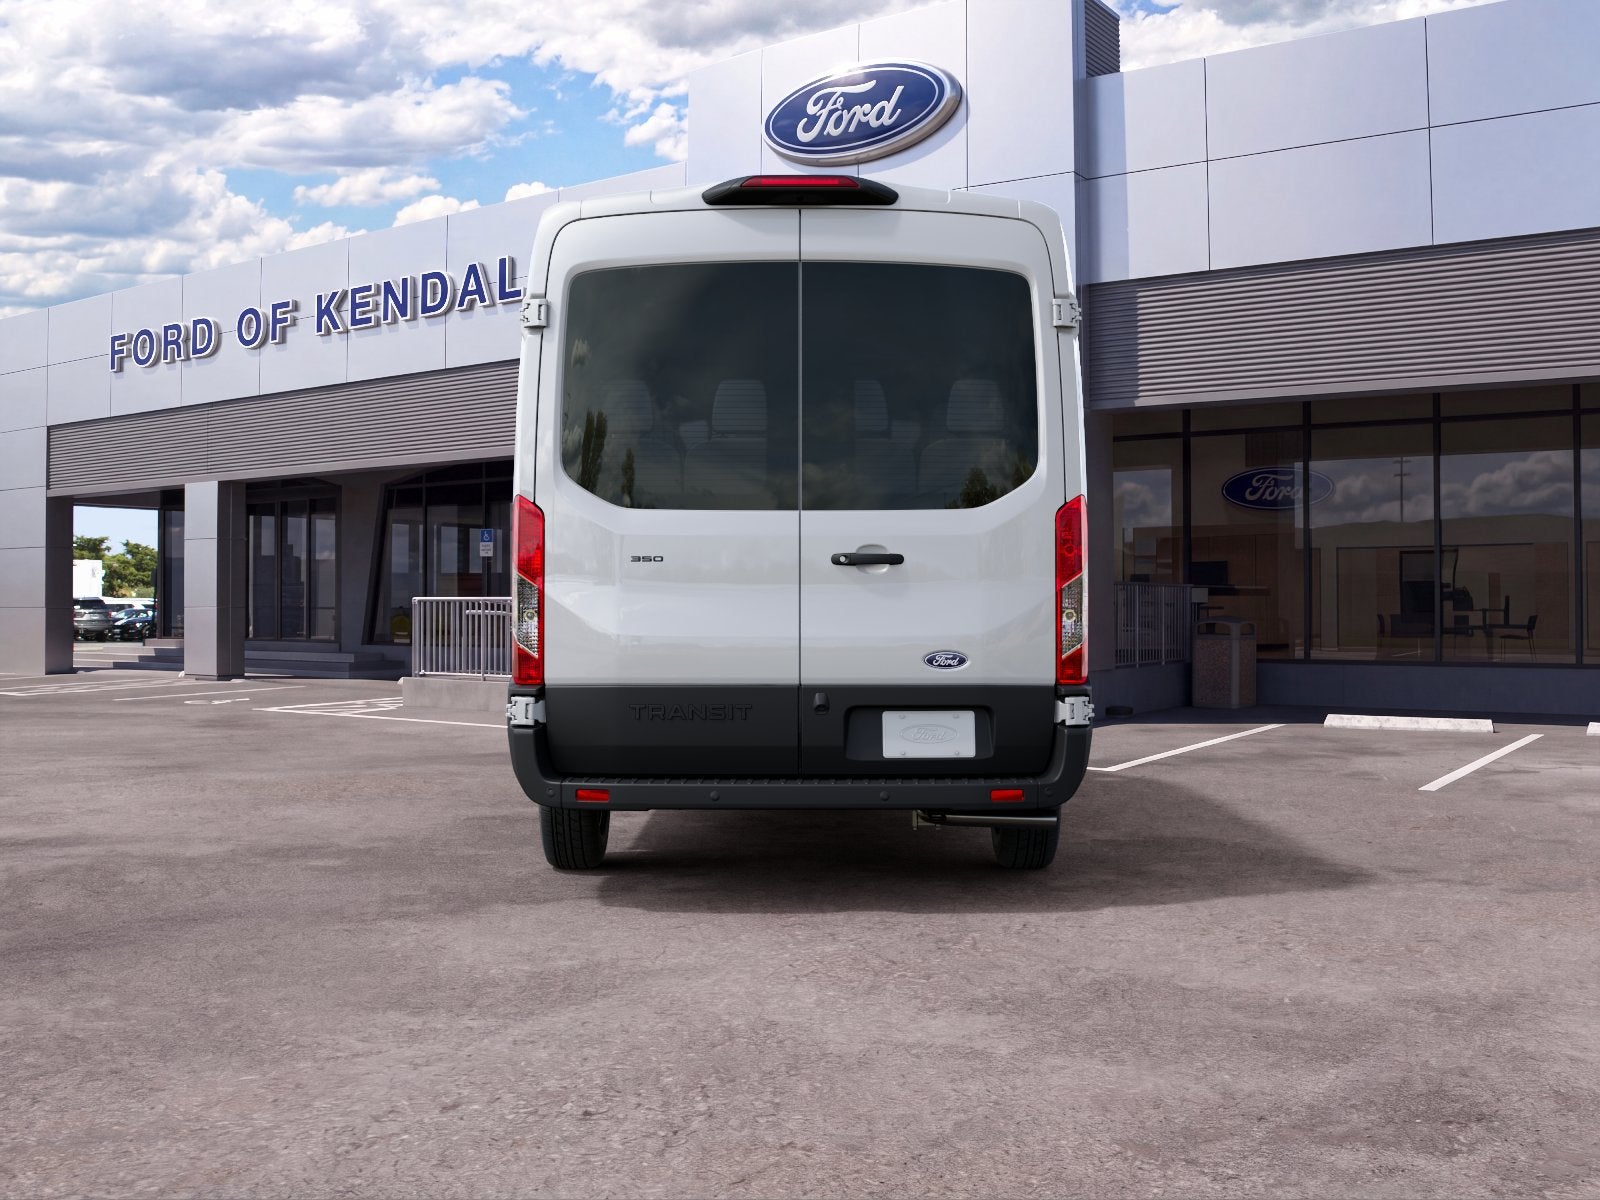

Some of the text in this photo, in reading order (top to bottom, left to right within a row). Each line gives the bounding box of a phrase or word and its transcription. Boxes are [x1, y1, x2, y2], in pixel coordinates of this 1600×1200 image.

[796, 80, 905, 143] Ford
[109, 255, 525, 373] FORD OF KENDAL
[630, 555, 664, 563] 350
[932, 654, 961, 666] Ford
[629, 703, 753, 721] TRANSIT
